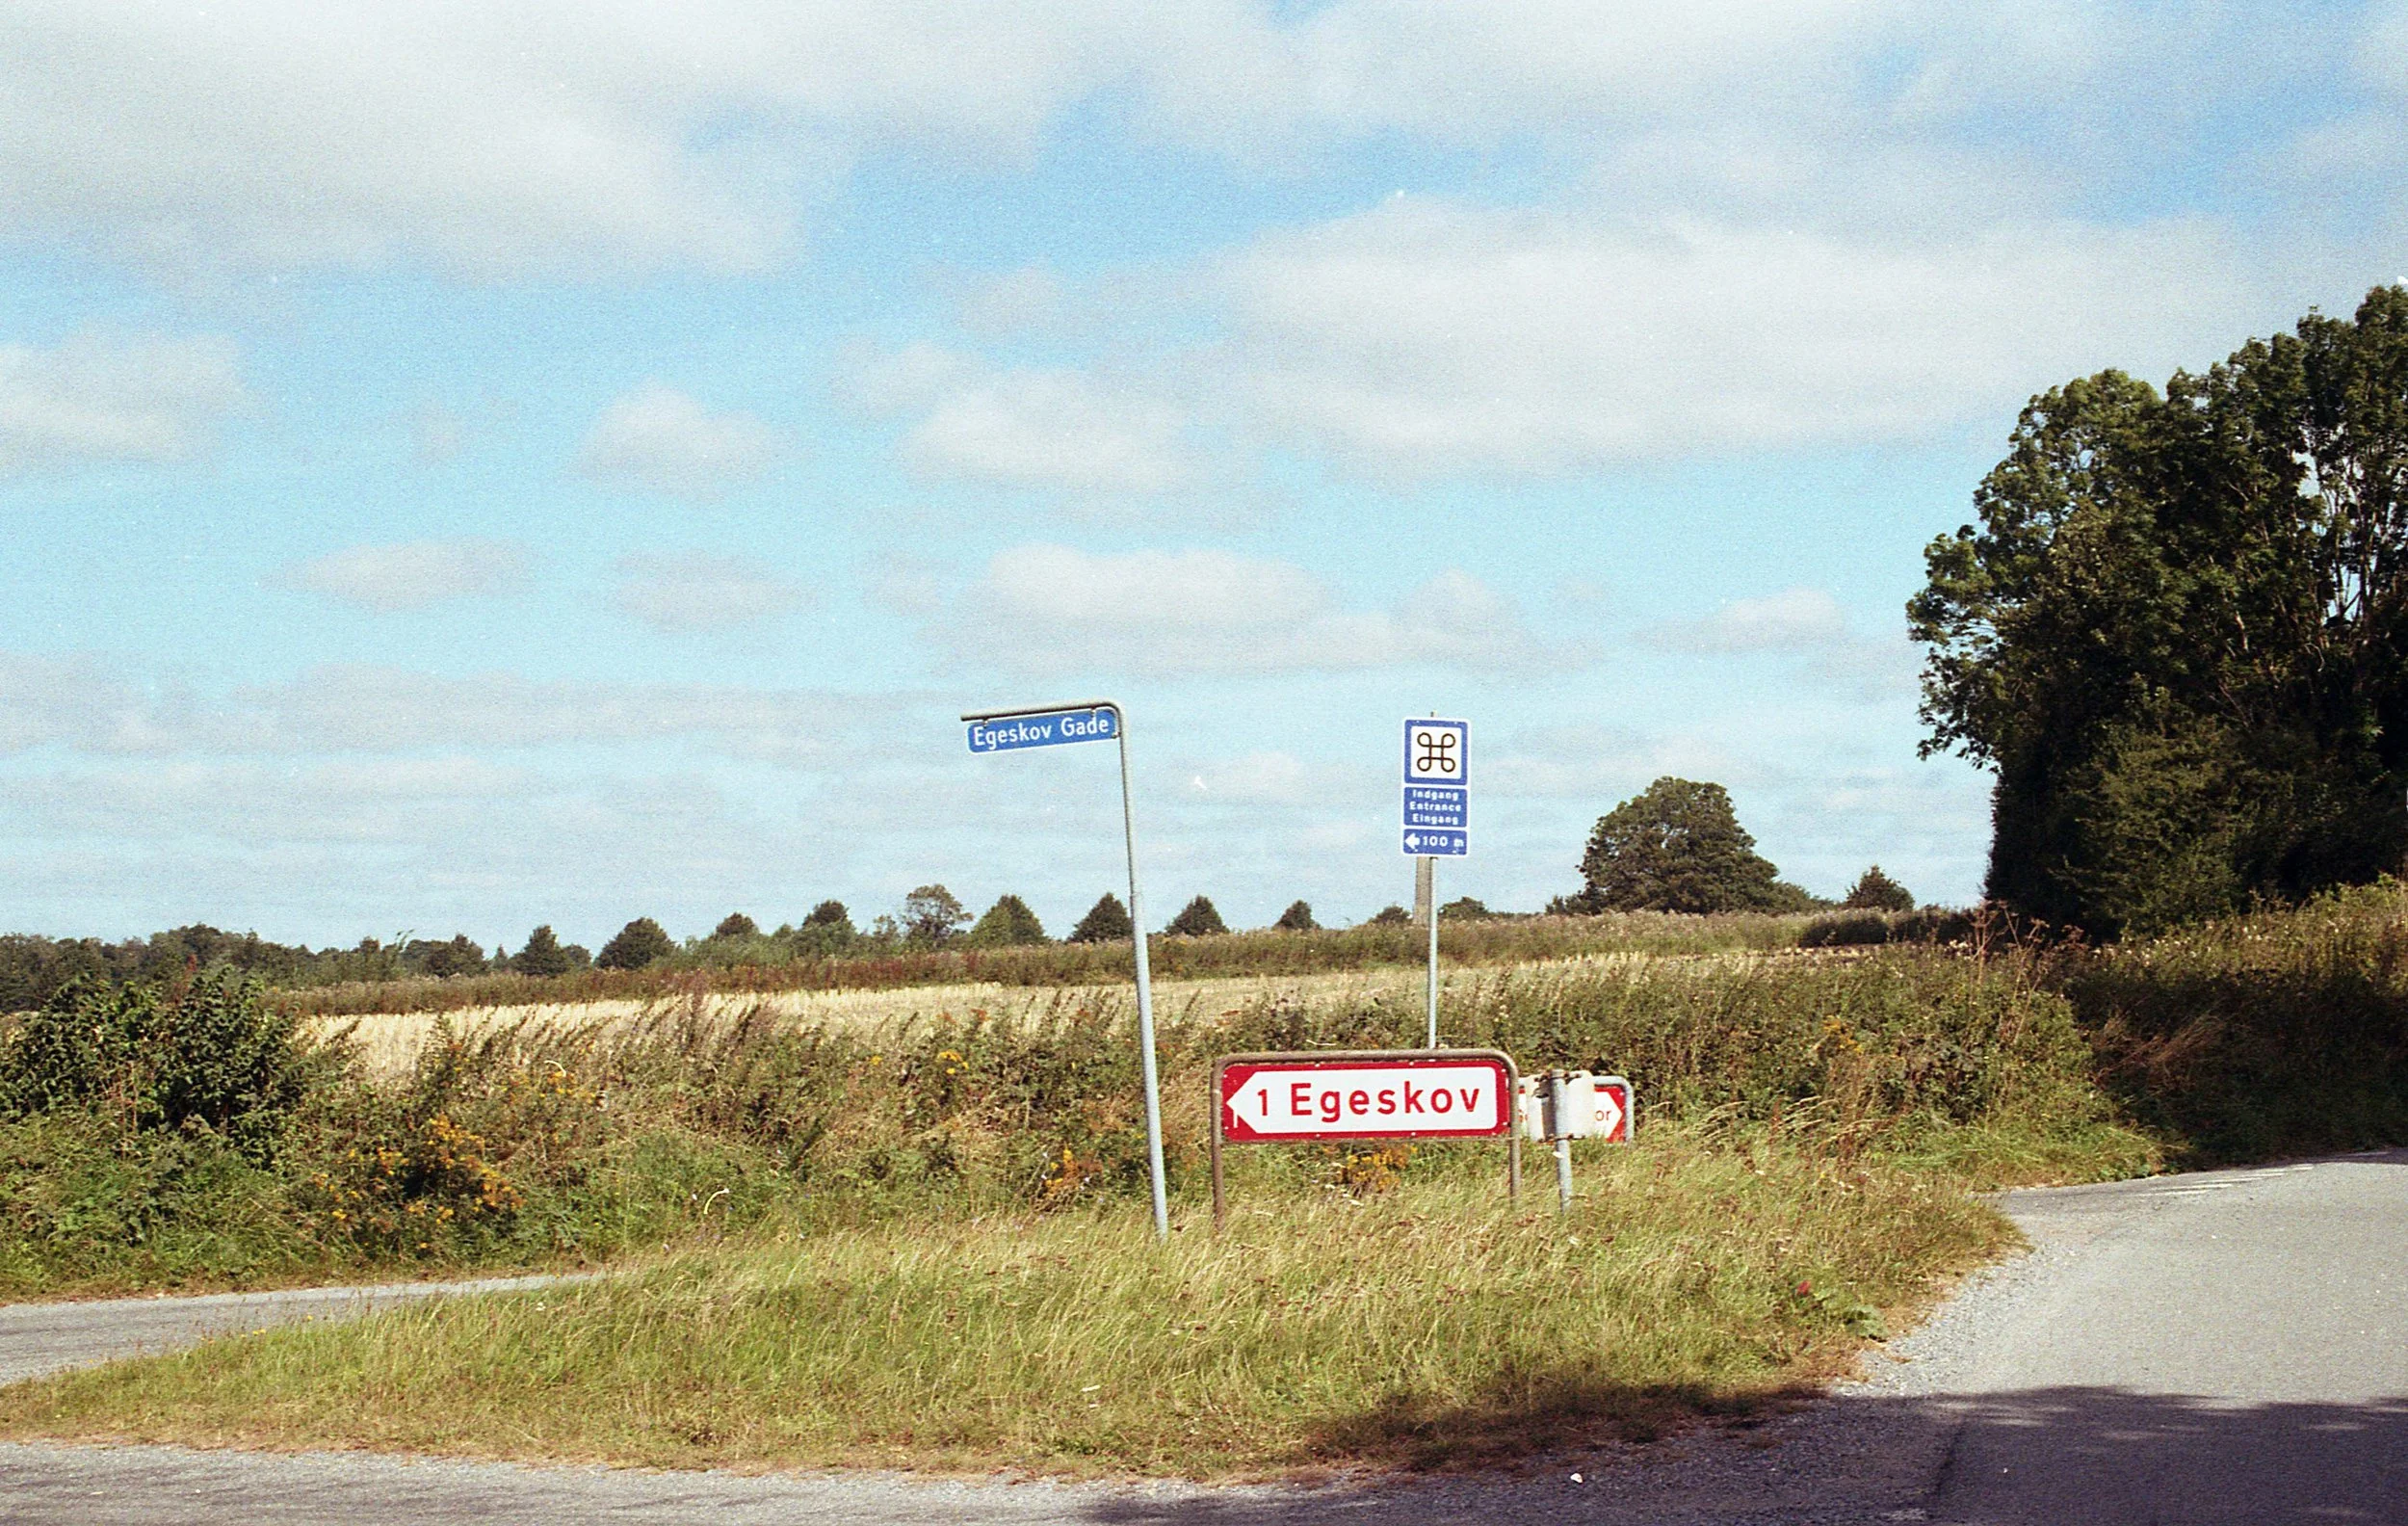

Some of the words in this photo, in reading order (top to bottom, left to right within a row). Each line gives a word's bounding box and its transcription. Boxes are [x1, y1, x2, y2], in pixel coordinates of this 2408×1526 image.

[974, 723, 1052, 750] Egeskov
[1060, 716, 1109, 737] Gade
[1412, 789, 1459, 801] Indgang
[1409, 801, 1462, 812] Entrance
[1412, 813, 1459, 826] Eingang
[1423, 835, 1449, 847] 100
[1453, 838, 1464, 847] m
[1257, 1089, 1269, 1116] 1
[1290, 1080, 1480, 1123] Egeskov
